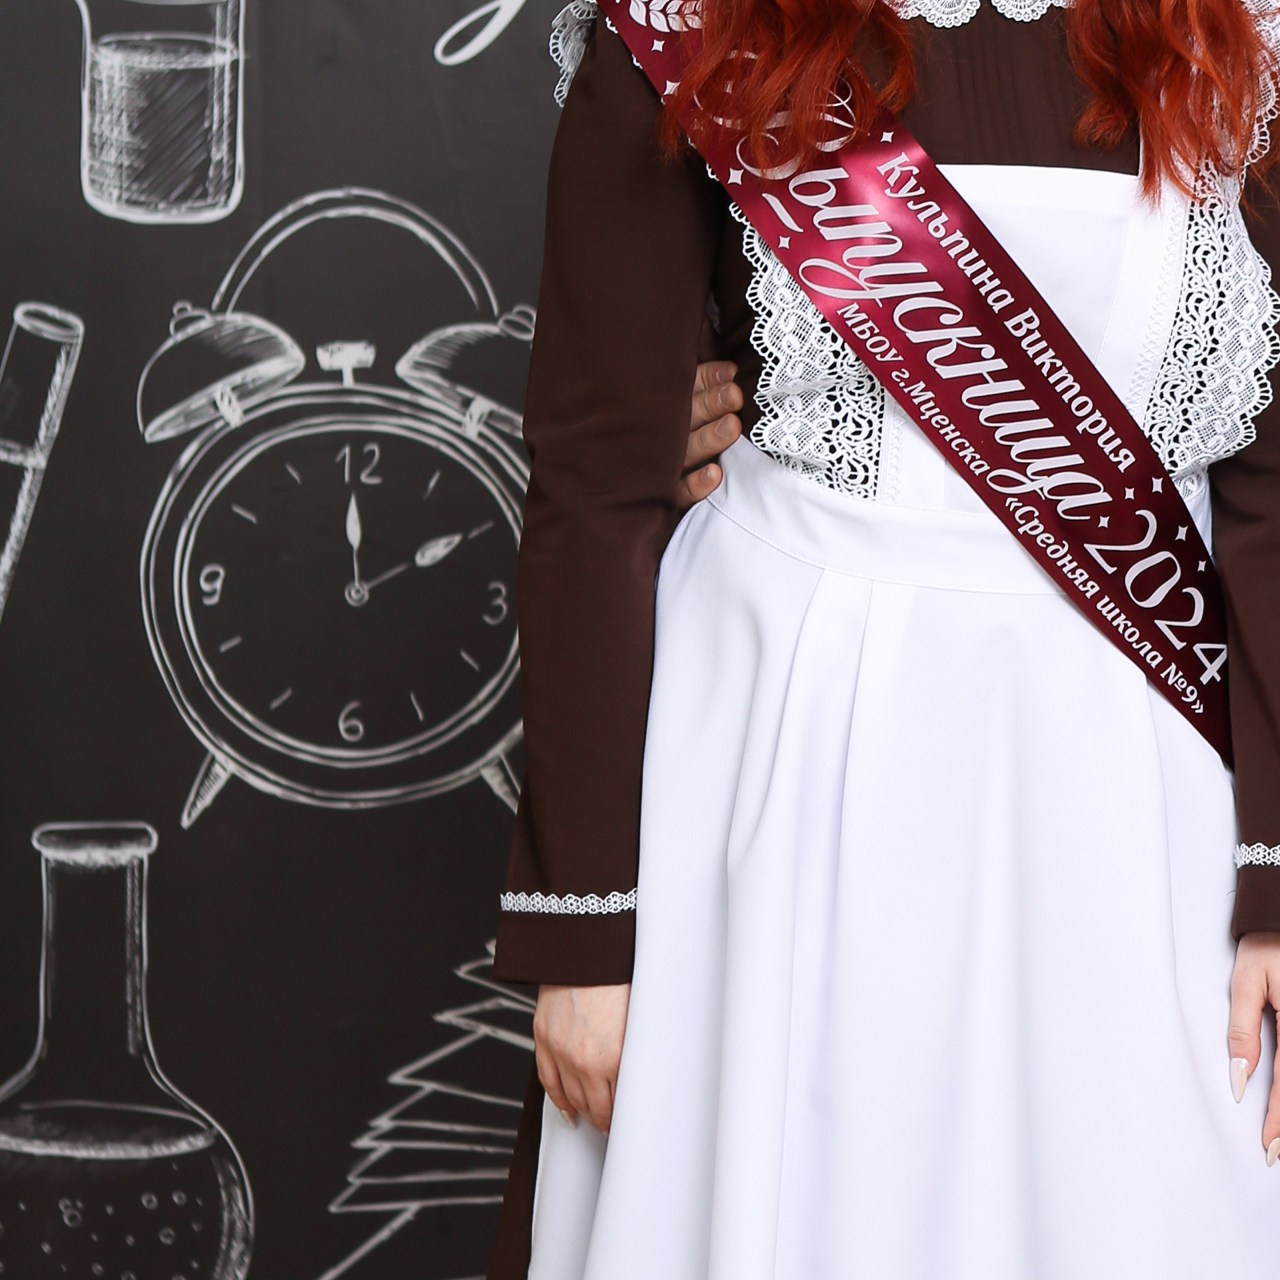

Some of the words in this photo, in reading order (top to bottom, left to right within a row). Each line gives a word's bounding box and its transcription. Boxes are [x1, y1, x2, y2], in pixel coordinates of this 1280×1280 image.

[876, 151, 1016, 315] Кульпина
[1003, 307, 1137, 474] Виктория
[334, 442, 383, 486] 12
[836, 301, 904, 363] МБОУ
[890, 367, 991, 476] г.Мценска
[1005, 496, 1101, 600] «Средняя
[1095, 595, 1164, 669] школа
[1159, 662, 1205, 714] №9»
[199, 563, 226, 607] 9
[481, 580, 508, 625] 3
[1083, 509, 1228, 686] 2024
[338, 700, 365, 742] 6
